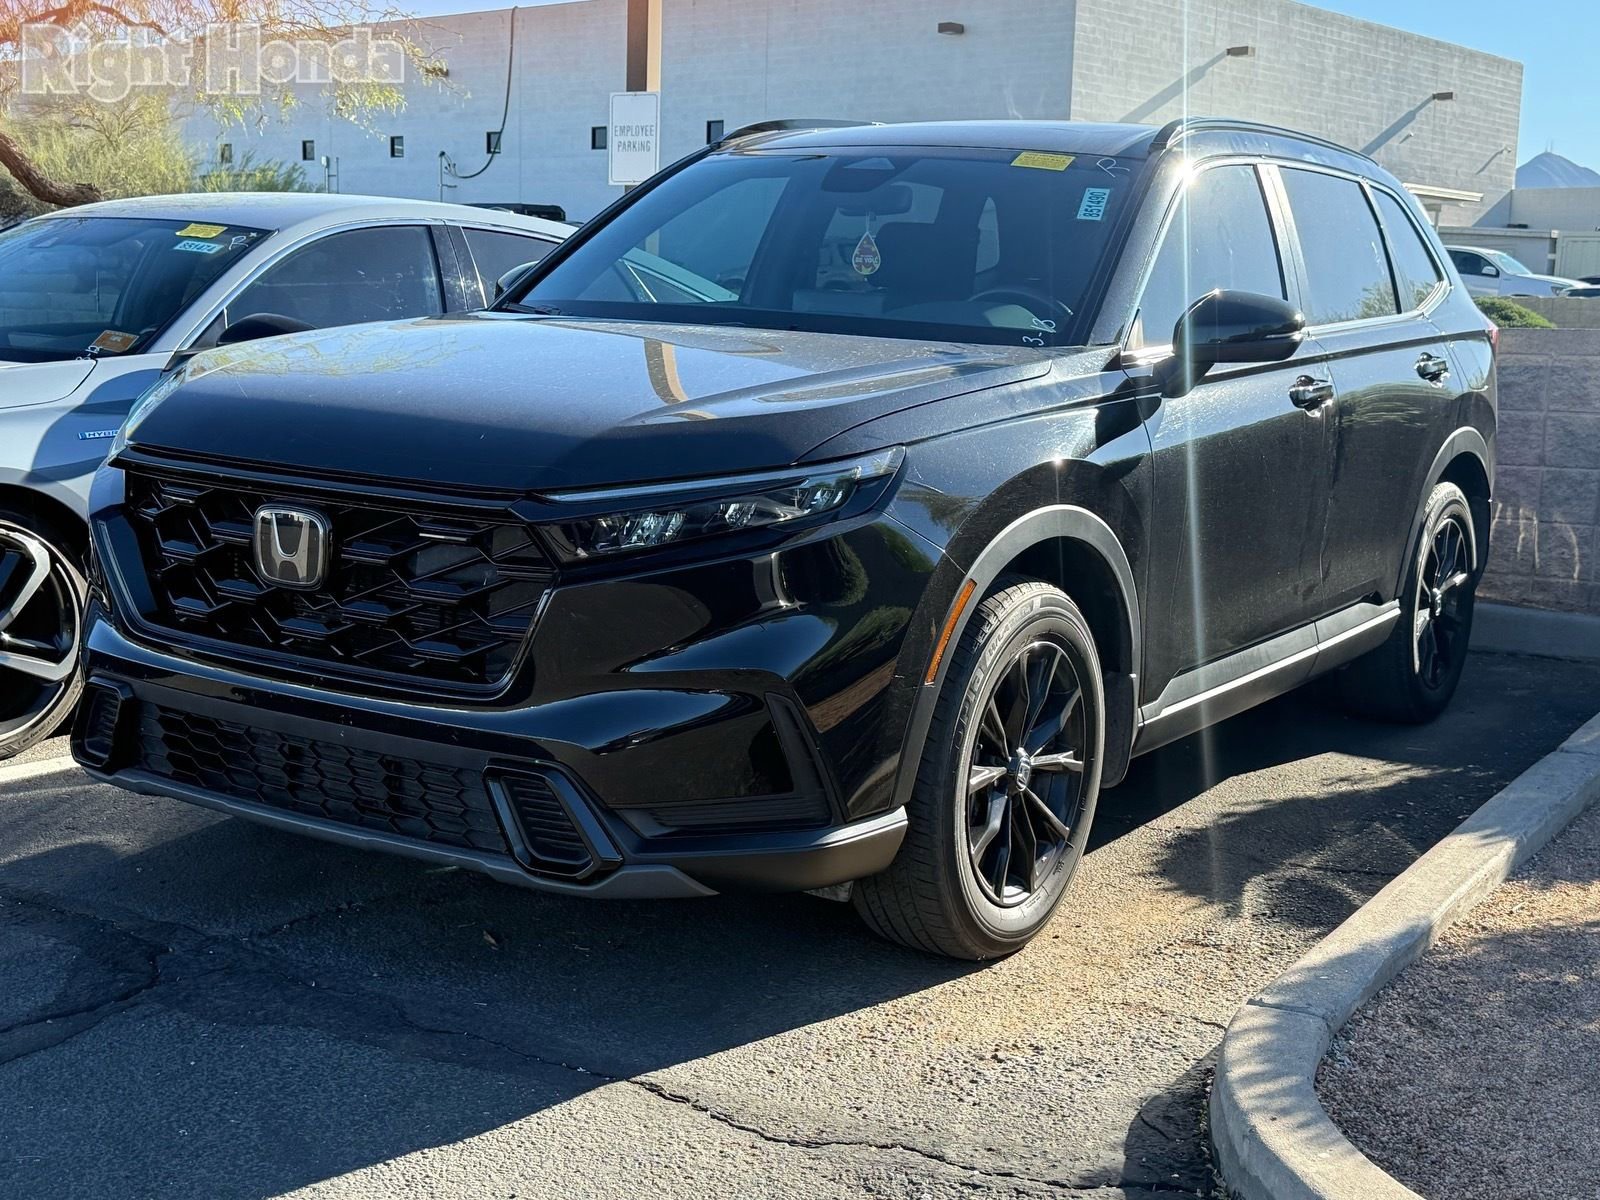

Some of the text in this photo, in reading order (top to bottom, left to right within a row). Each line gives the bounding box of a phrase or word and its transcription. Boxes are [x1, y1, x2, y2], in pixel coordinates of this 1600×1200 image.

[614, 124, 655, 137] EMPLOYEE
[617, 140, 651, 153] PARKING
[1082, 190, 1107, 218] 851490
